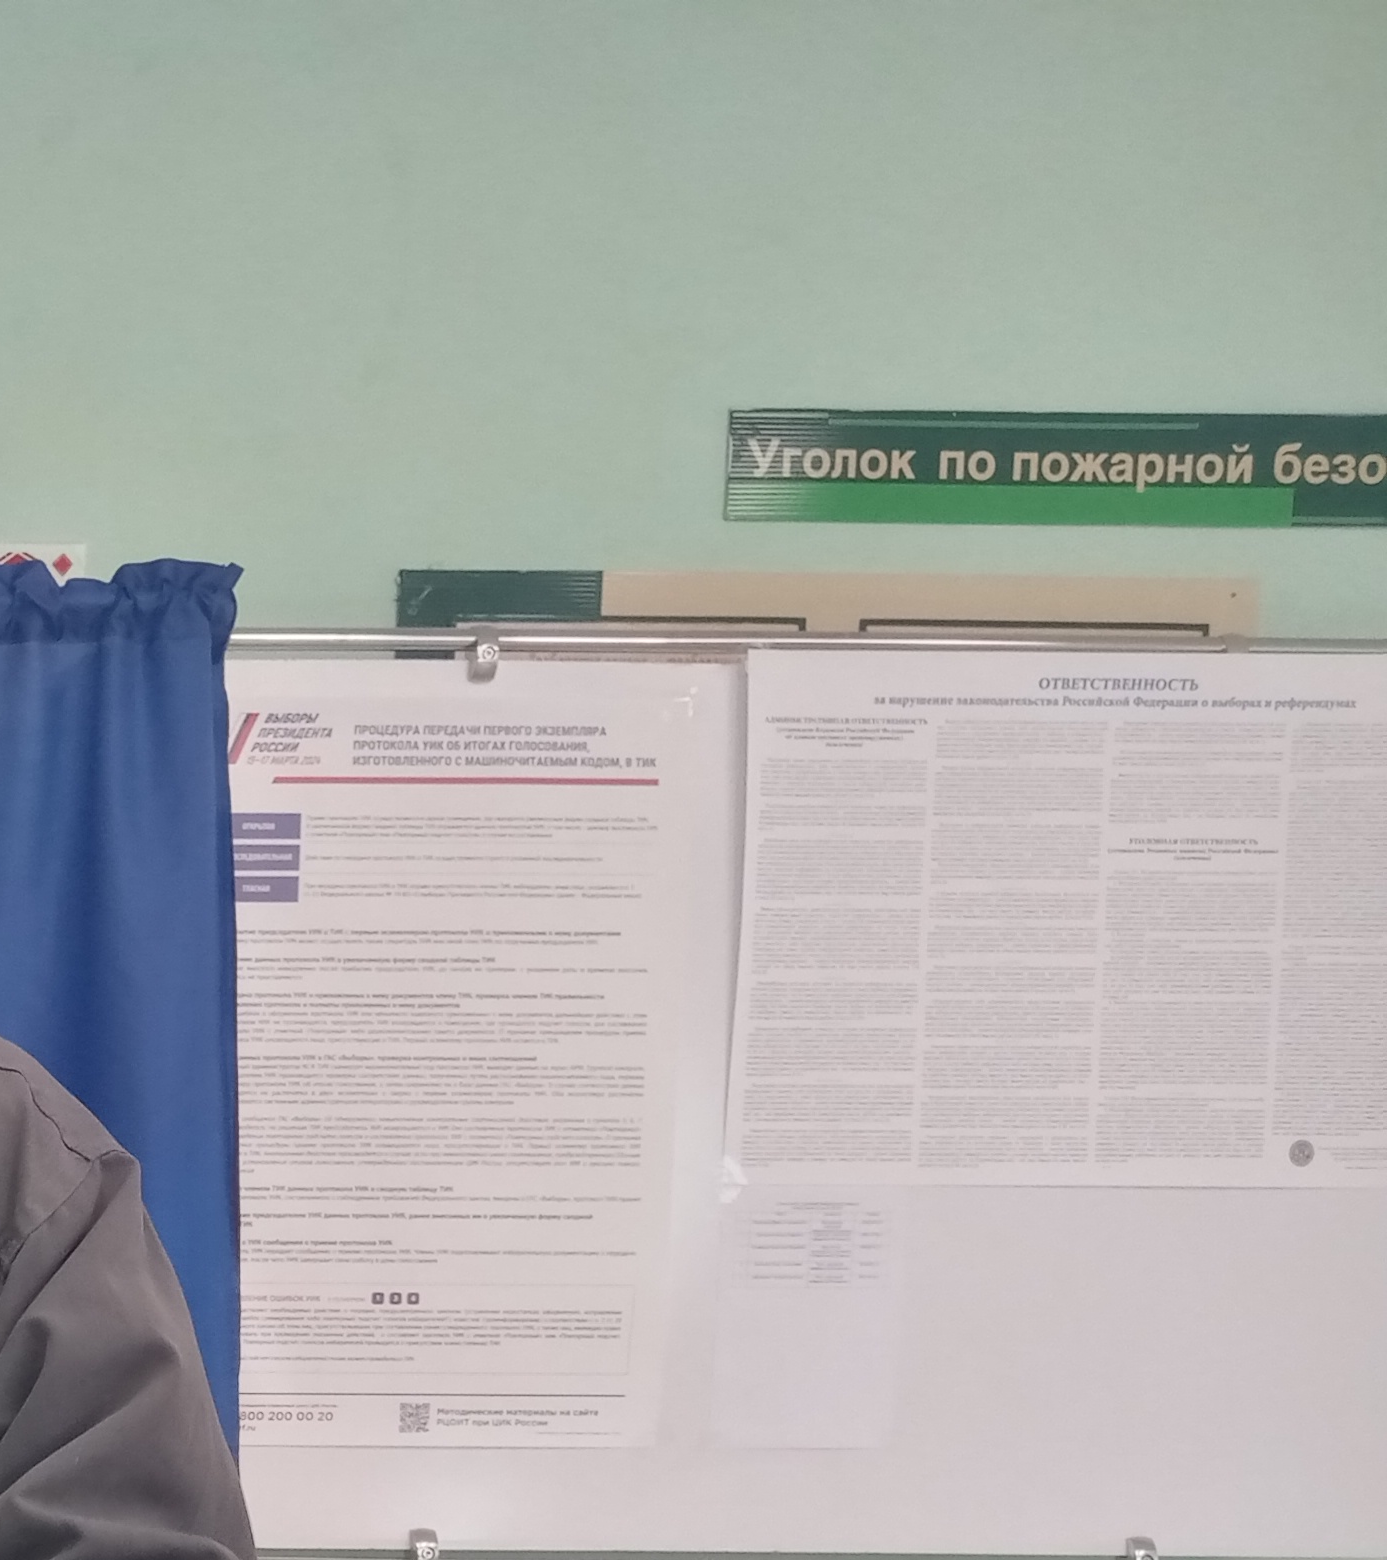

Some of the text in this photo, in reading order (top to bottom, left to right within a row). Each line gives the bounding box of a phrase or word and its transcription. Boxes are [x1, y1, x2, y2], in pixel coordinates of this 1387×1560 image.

[747, 438, 1387, 492] Уголок по пожарной безо
[1038, 677, 1199, 691] ОТВЕТСТВЕННОСТЬ
[1062, 696, 1130, 707] Российской
[1133, 696, 1198, 709] Федерации
[264, 713, 319, 723] ВЫБОРЫ
[257, 728, 333, 738] ПРЕЗИДЕНТА
[354, 725, 607, 737] ПРОЦЕДУРА ПЕРЕДАЧИ ПЕРВОГО ЭКЗЕМПЛЯРА
[251, 742, 300, 752] РОССИИ
[353, 740, 590, 753] ПРОТОКОЛА УИК ОБ ИТОГАХ ГОЛОСОВАНИЯ,
[352, 756, 452, 766] ИЗГОТОВЛЕННОГО
[454, 756, 462, 766] С
[465, 756, 577, 766] МАШИНОЧИТАЕМЫМ
[635, 758, 657, 767] ТИК
[267, 1411, 293, 1421] 200
[296, 1411, 314, 1421] 00
[317, 1411, 334, 1421] 20
